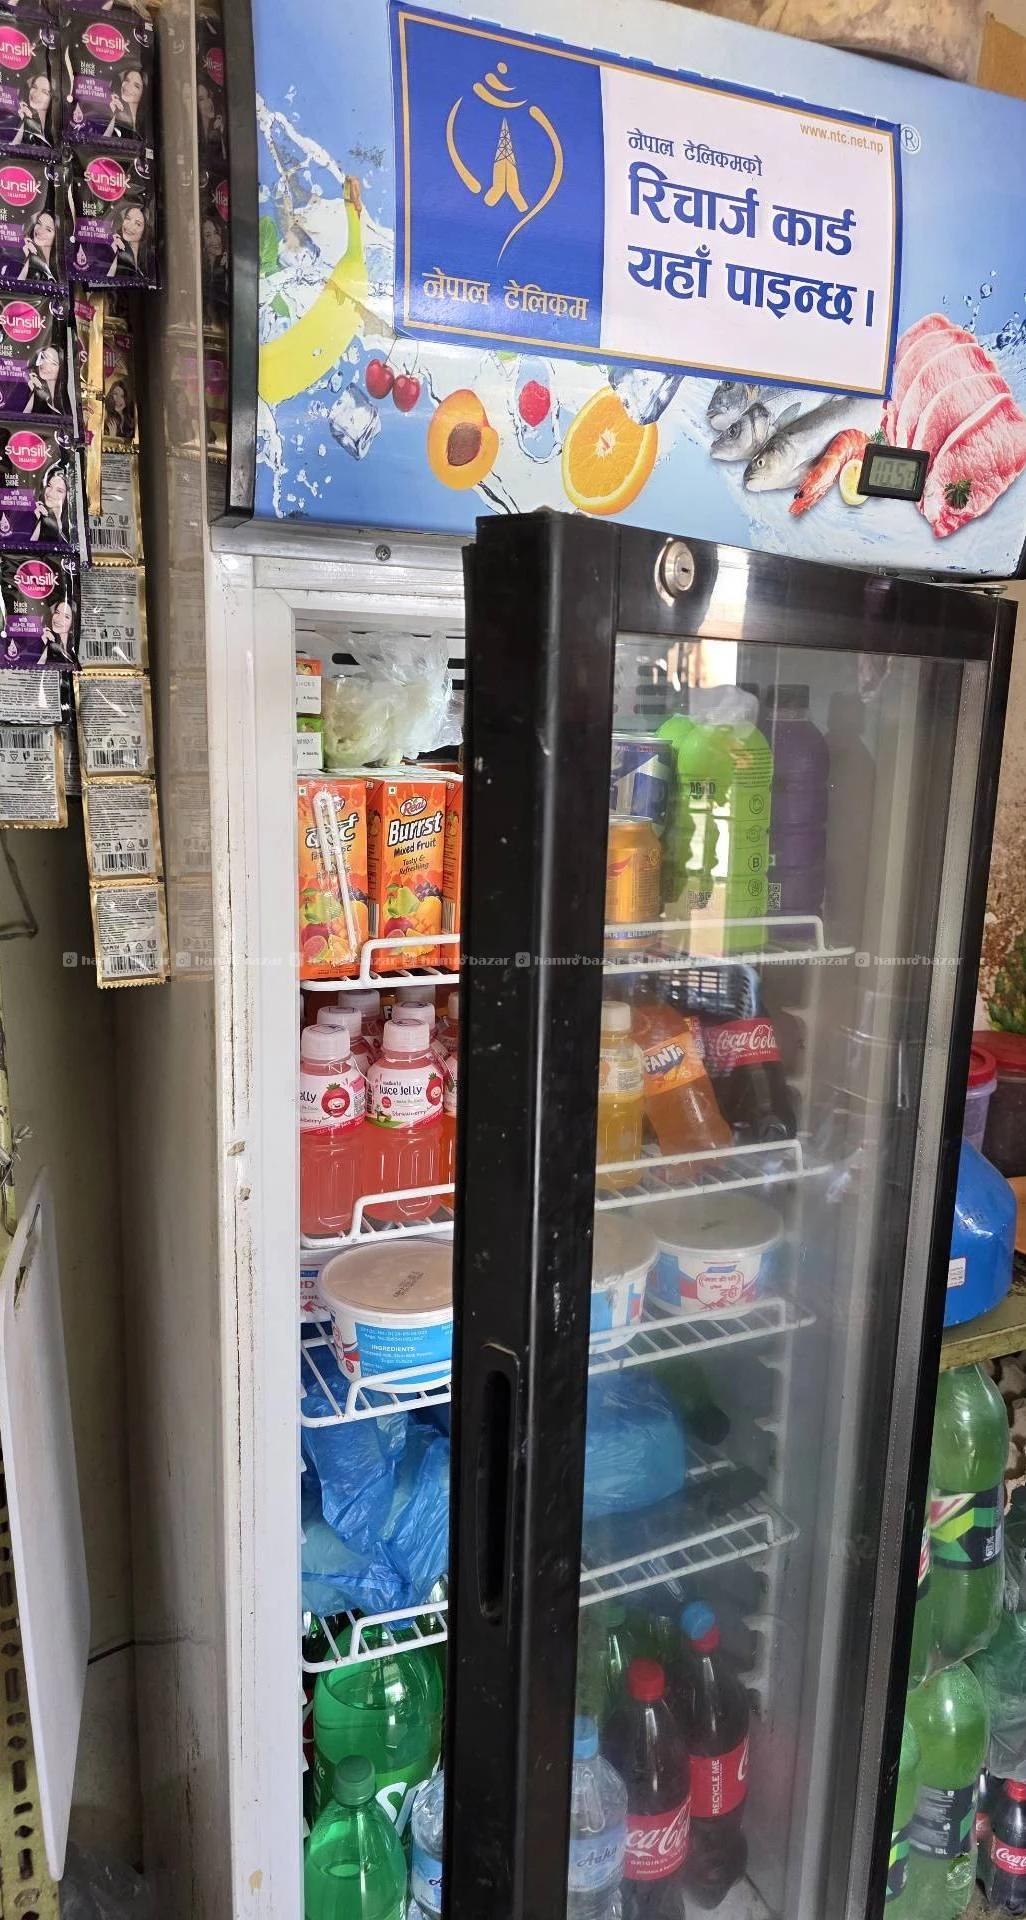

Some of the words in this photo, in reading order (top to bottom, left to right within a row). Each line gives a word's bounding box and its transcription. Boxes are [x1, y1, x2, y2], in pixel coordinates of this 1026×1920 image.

[81, 33, 130, 53] sunsilk
[800, 122, 884, 154] www.ntc.net.np
[627, 128, 674, 157] नेपाल
[683, 140, 763, 177] टेलिकमको
[84, 171, 131, 189] sunsilk
[628, 162, 759, 239] रिचार्ज
[773, 203, 857, 257] कार्ड
[627, 244, 712, 300] यहाँ
[422, 267, 490, 307] नेपाल
[504, 278, 589, 321] टेलिकम
[0, 314, 46, 329] sunsilk
[5, 444, 52, 458] sunsilk
[14, 572, 59, 586] sunsilk
[403, 800, 425, 815] Real
[387, 811, 443, 848] Burrst
[393, 844, 415, 859] Mixed
[416, 838, 437, 851] Fruit
[643, 1044, 685, 1072] FANTA
[712, 1760, 719, 1774] ME
